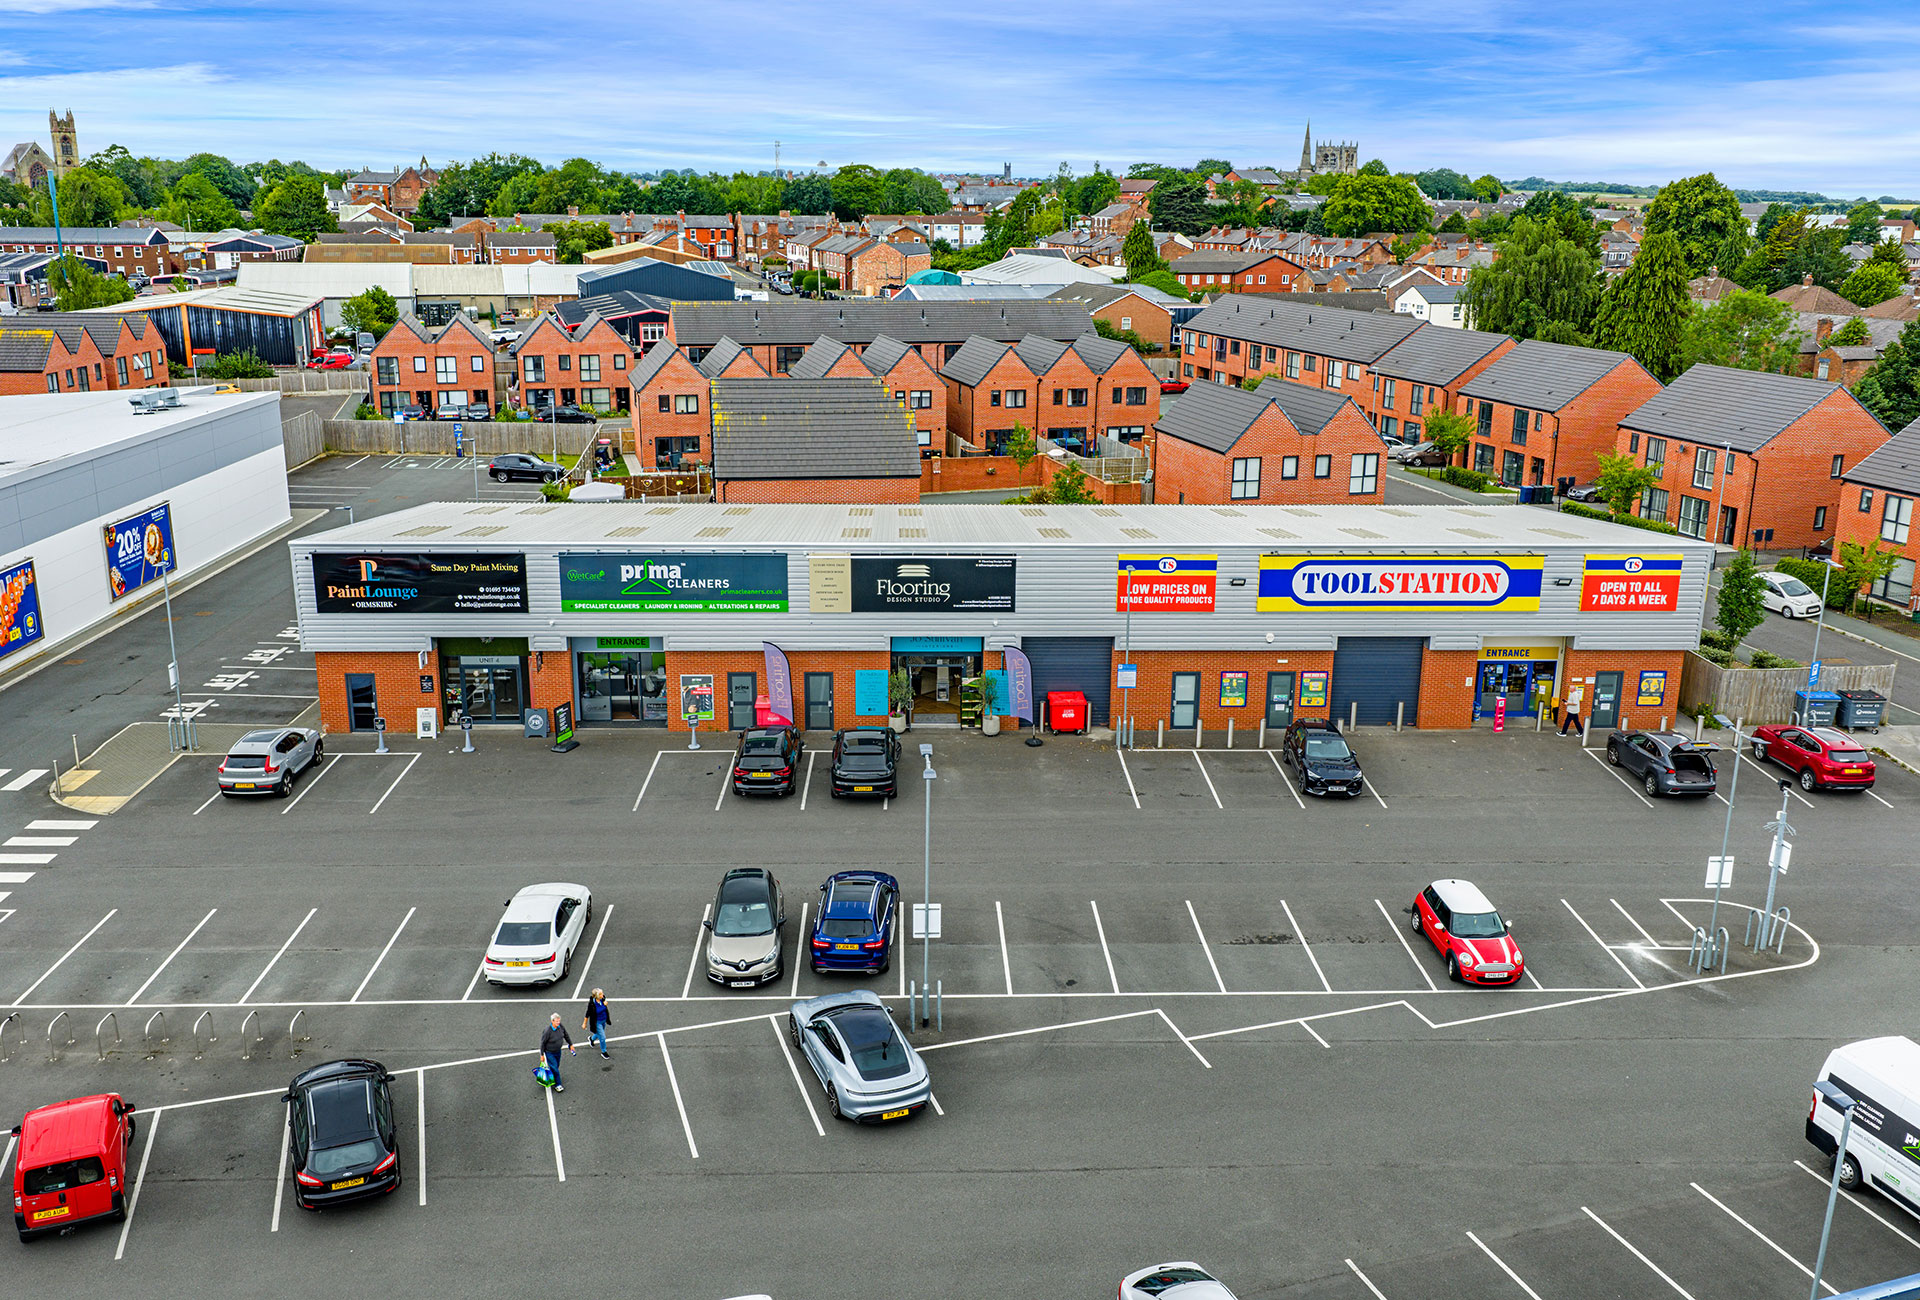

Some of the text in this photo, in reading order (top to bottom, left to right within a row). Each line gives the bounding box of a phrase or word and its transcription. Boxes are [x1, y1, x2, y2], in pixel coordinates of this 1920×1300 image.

[453, 564, 469, 573] Day
[491, 563, 519, 573] Mixing
[1161, 561, 1175, 569] TS
[1627, 561, 1640, 569] TS
[667, 579, 730, 588] CLEANERS
[1302, 572, 1501, 594] TOOLSTATION
[1600, 582, 1662, 592] OPEN TO ALL
[327, 585, 418, 600] PaintLounge
[877, 579, 950, 602] Flooring
[1127, 584, 1207, 594] LOW PRICES ON
[1120, 596, 1213, 604] TRADE QUALITY PRODUCTS
[1592, 594, 1668, 605] 7 DAYS A WEEK
[600, 638, 646, 646] ENTRANCE
[1486, 649, 1530, 657] ENTRANCE
